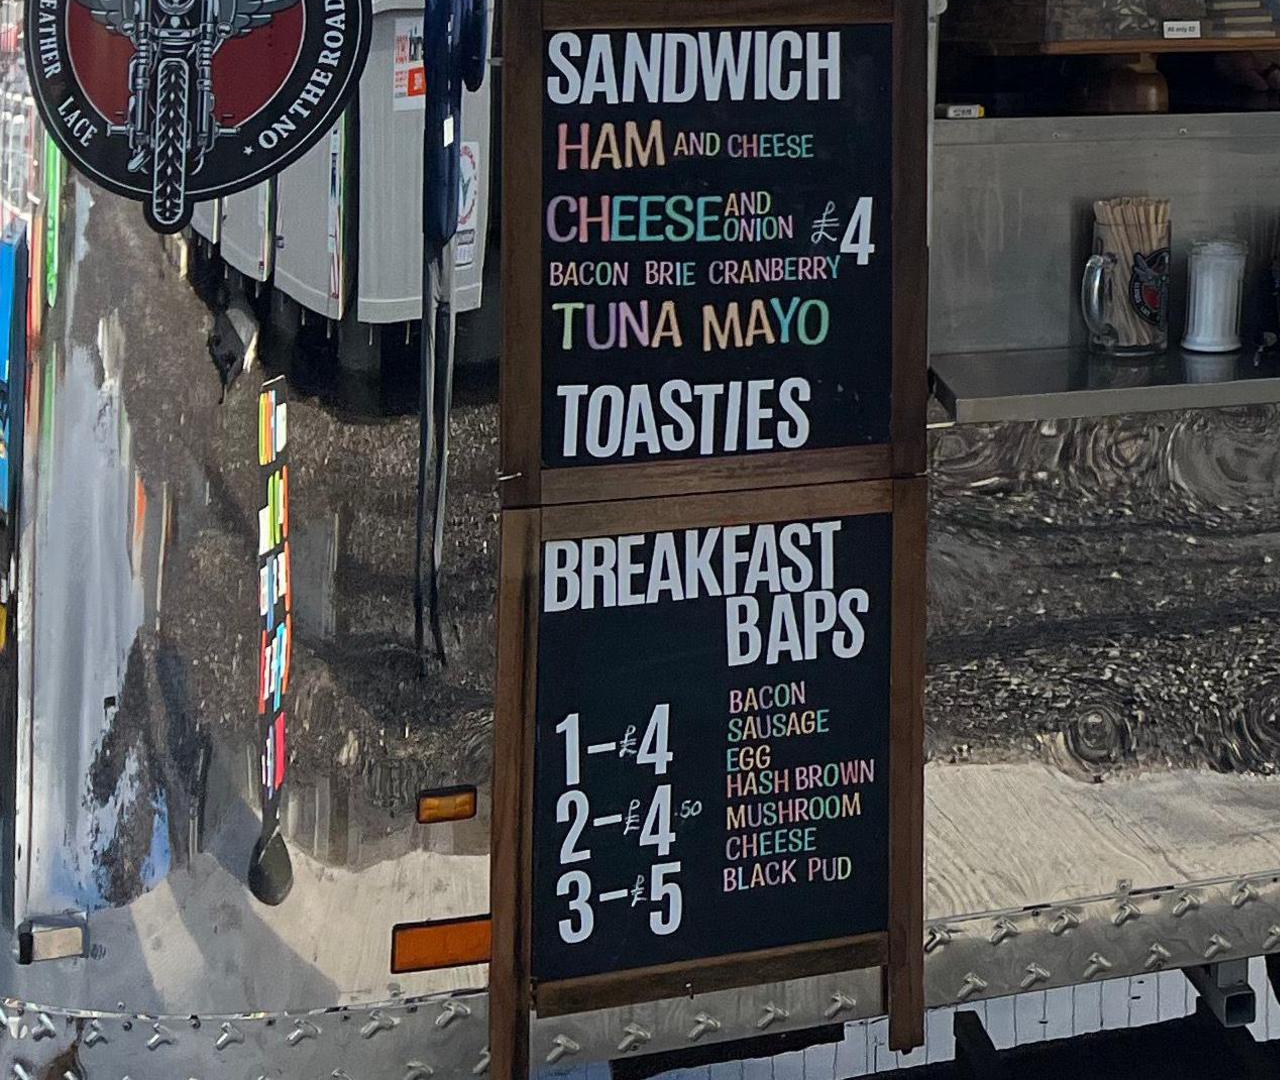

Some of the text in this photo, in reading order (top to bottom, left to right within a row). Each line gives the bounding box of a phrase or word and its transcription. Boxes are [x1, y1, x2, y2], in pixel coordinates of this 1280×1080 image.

[547, 30, 841, 105] SANDWICH
[57, 95, 98, 149] LACE
[257, 113, 293, 151] ON
[289, 68, 331, 119] THE
[557, 119, 815, 171] HAM AND CHEESE
[546, 190, 875, 266] CHEESE AND ONION £4
[549, 255, 841, 287] BACON BRIE CRANBERRY
[552, 297, 829, 352] TUNA MAYO
[556, 376, 812, 458] TOASTIES
[543, 520, 842, 613] BREAKFAST
[726, 588, 869, 667] BAPS
[728, 681, 806, 715] BACON
[727, 709, 830, 743] SAUSAGE
[726, 745, 771, 772] EGG
[726, 758, 875, 799] HASH BROWN
[726, 792, 861, 831] MUSHROOM
[725, 827, 817, 861] CHEESE
[722, 856, 852, 893] BLACK PUD
